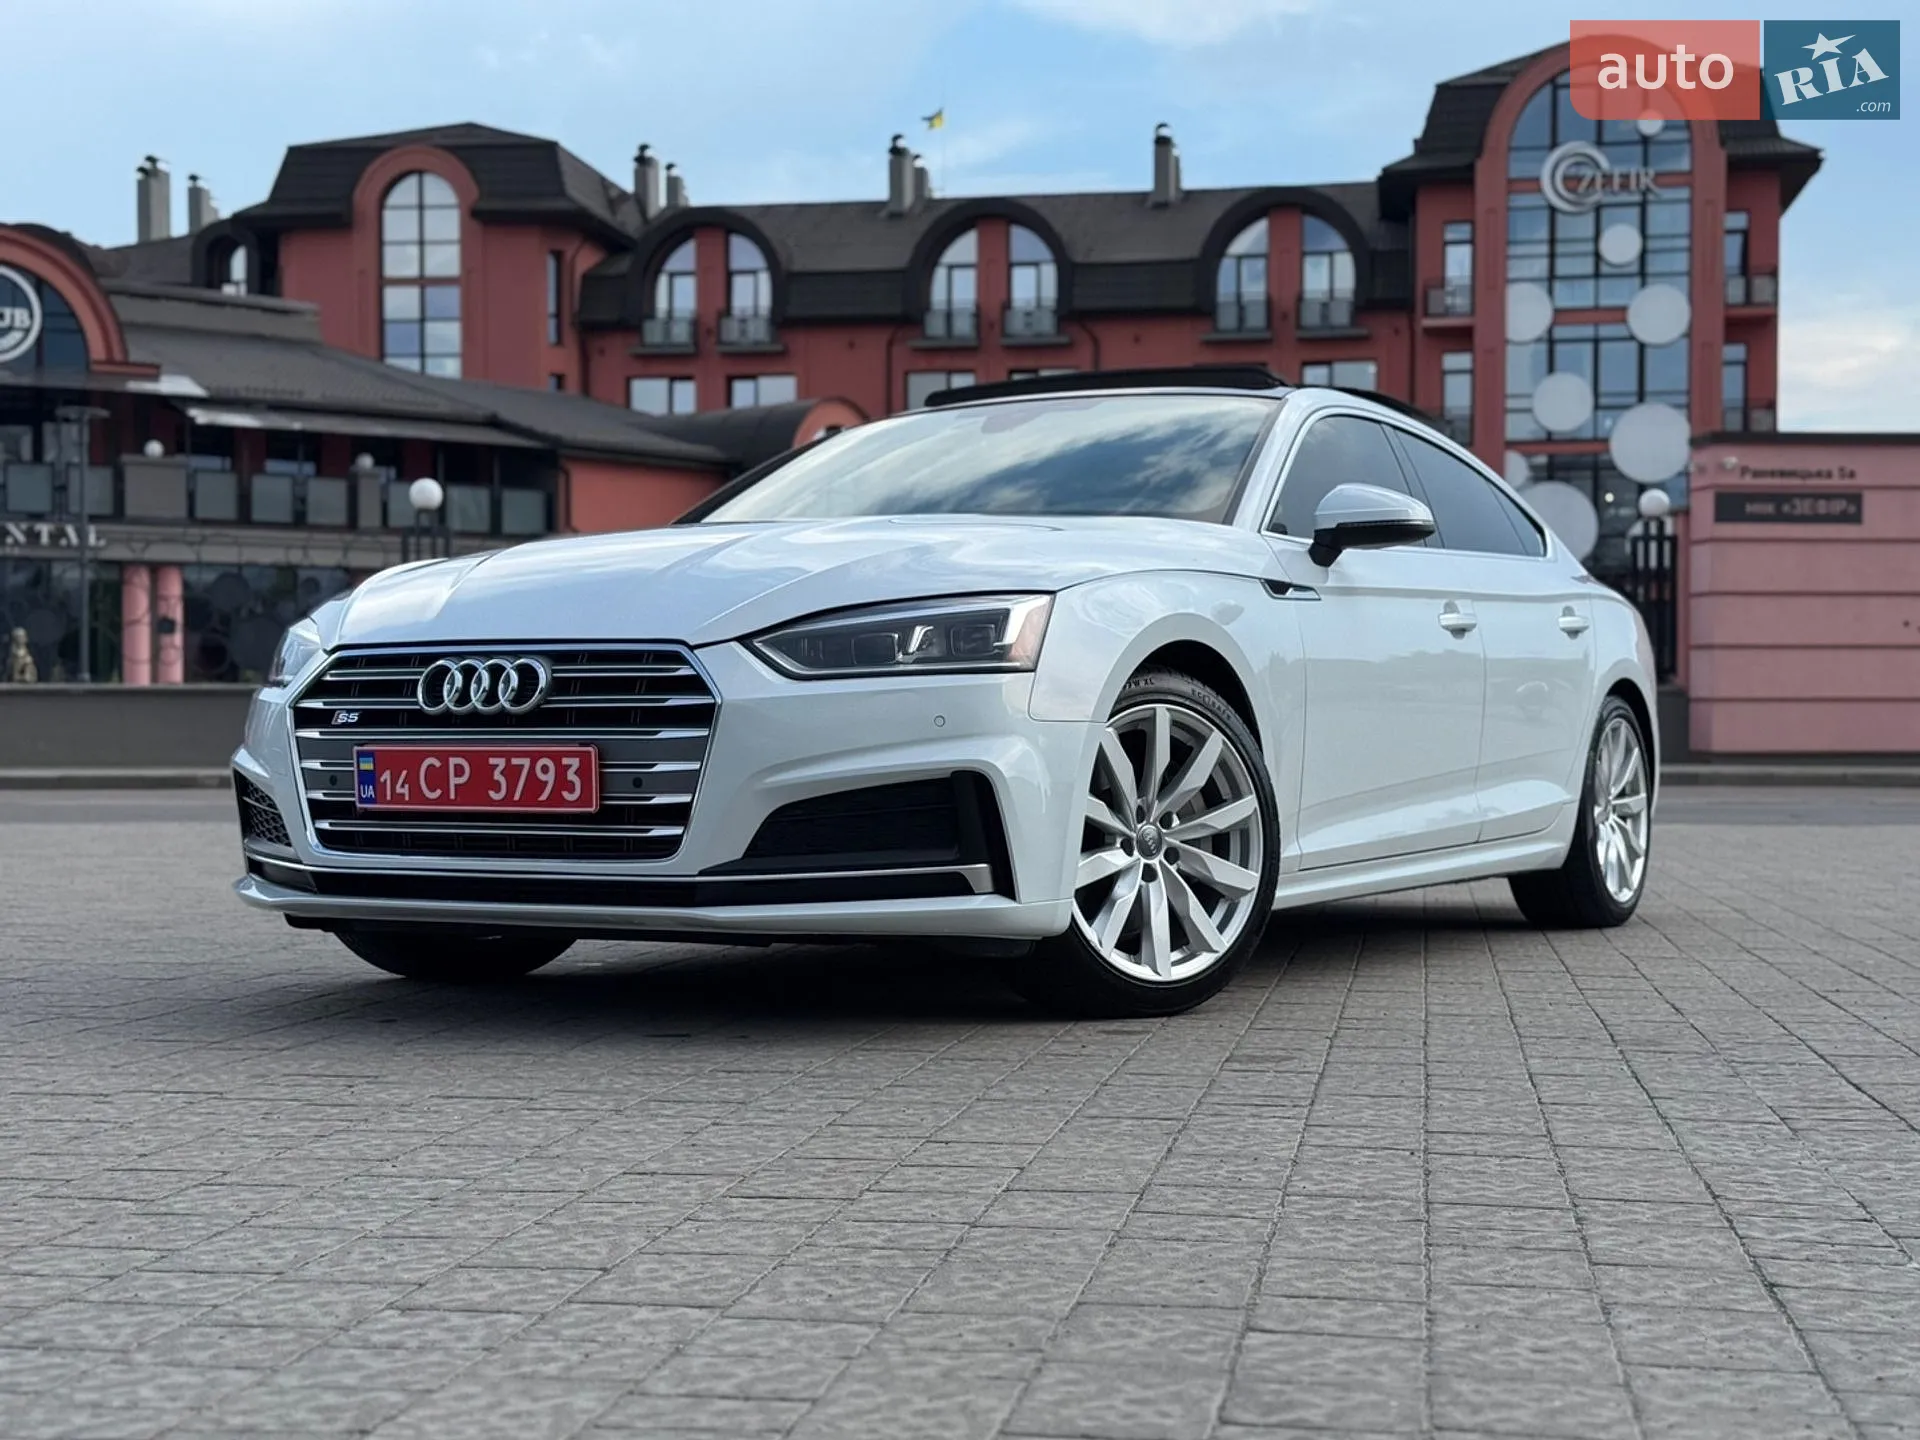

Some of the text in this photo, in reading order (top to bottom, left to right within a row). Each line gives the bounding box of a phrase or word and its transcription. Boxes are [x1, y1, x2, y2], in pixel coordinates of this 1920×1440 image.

[360, 785, 376, 799] UA
[380, 769, 410, 801] 14
[487, 756, 582, 802] 3793
